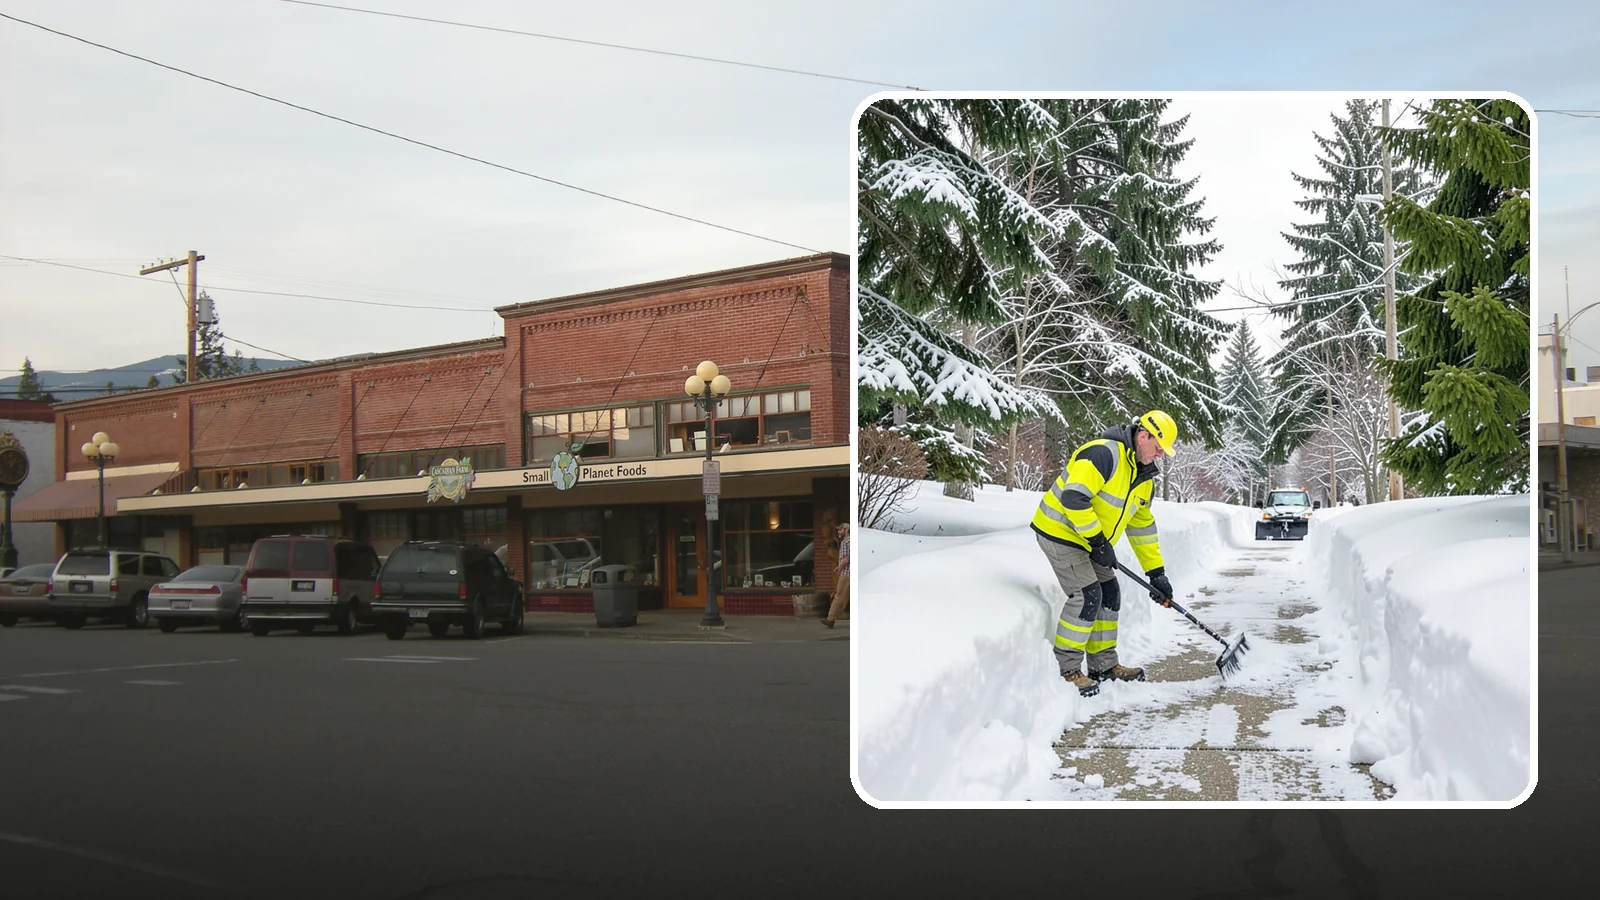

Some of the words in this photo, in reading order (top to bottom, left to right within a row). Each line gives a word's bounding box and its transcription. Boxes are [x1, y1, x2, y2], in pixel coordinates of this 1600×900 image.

[523, 471, 549, 483] Small
[582, 466, 614, 479] Planet
[617, 464, 647, 477] Foods
